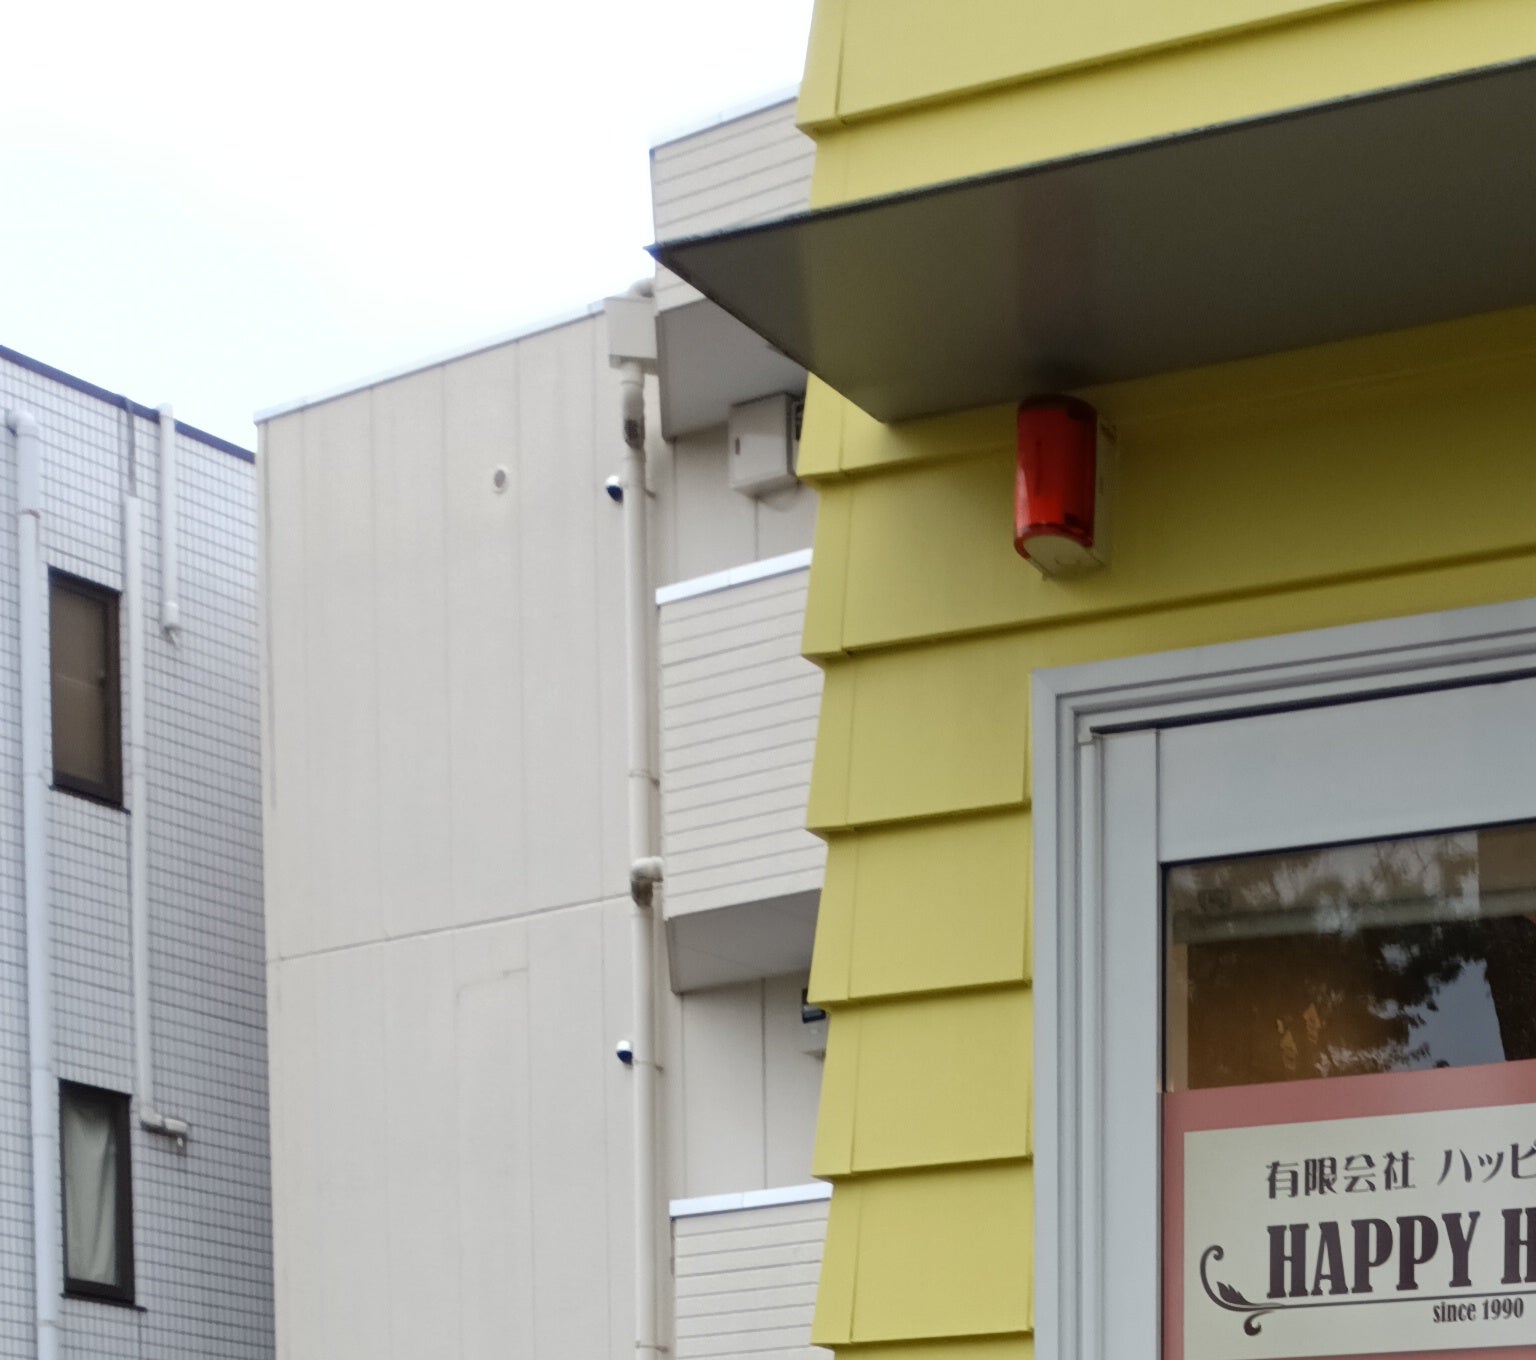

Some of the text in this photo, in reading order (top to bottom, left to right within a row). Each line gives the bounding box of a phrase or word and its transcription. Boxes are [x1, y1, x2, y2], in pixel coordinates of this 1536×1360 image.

[1266, 1150, 1416, 1200] 有限会社
[1266, 1211, 1481, 1299] HAPPY
[1433, 1297, 1524, 1323] since 1990
